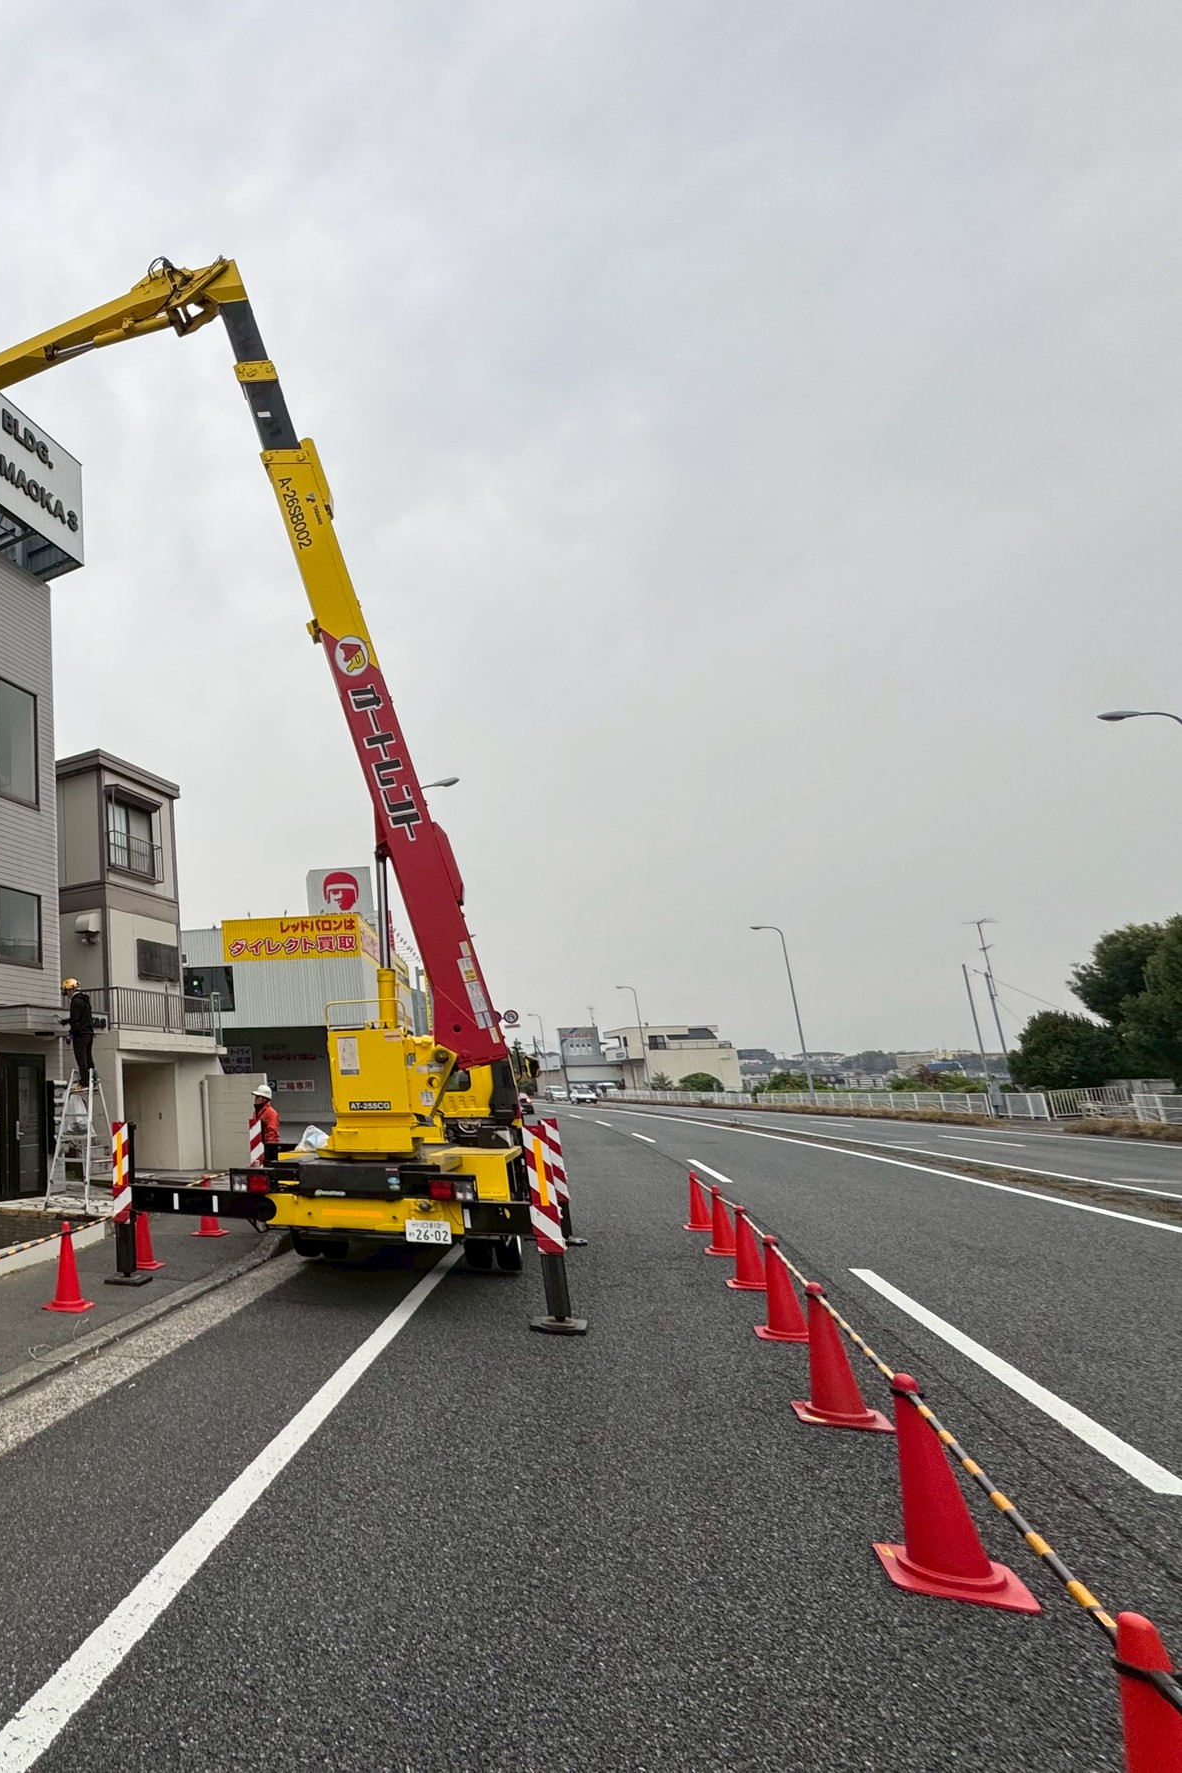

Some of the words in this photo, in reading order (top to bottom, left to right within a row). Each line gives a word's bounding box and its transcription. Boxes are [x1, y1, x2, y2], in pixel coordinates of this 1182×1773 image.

[2, 408, 53, 469] BLDG.
[278, 477, 312, 550] A-26SB002
[348, 684, 422, 842] オートレント
[280, 918, 355, 933] レッドバロンは
[229, 935, 356, 957] ダイレクト買取
[350, 1102, 391, 1111] AT-255CG
[416, 1229, 449, 1242] 26-02
